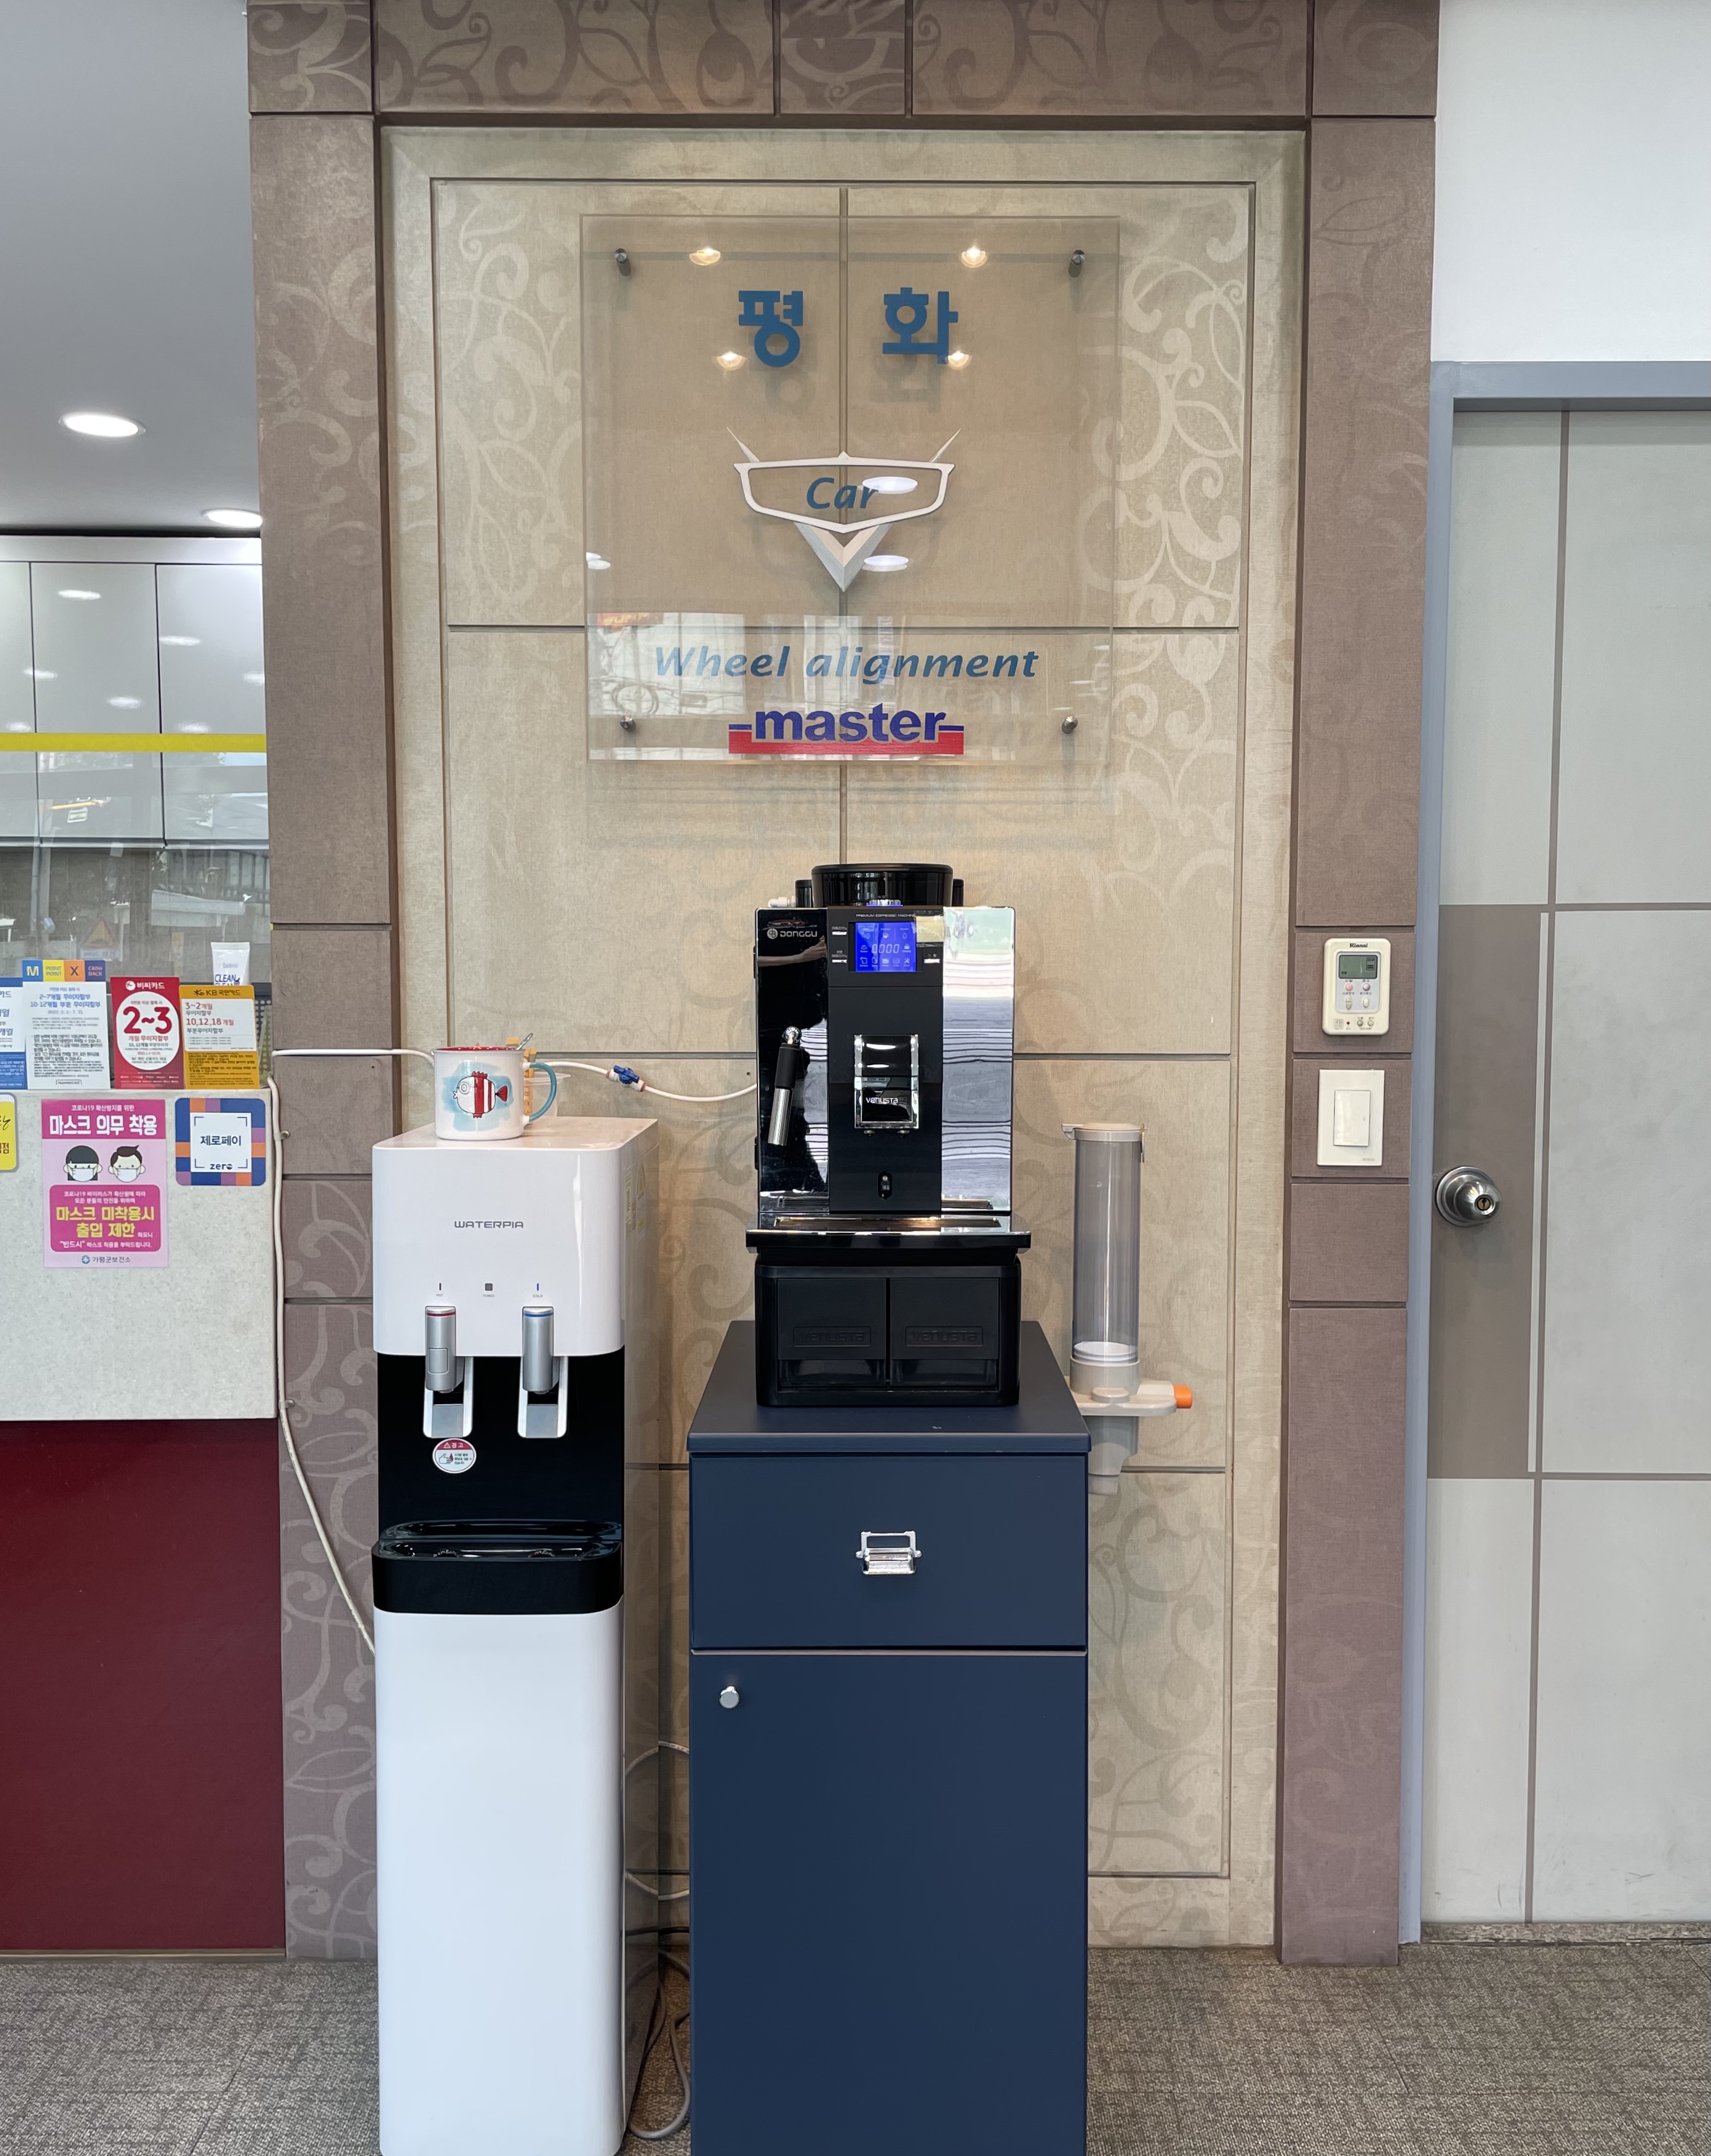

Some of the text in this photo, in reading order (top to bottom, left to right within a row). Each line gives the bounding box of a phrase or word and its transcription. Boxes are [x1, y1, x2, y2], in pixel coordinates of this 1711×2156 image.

[807, 477, 879, 509] Car
[655, 646, 790, 677] Wheel
[805, 646, 1039, 684] alignment
[755, 703, 946, 742] master
[871, 944, 900, 953] 0000
[27, 966, 39, 976] M
[70, 966, 79, 976] X
[123, 1006, 172, 1034] 2~3
[50, 1114, 157, 1136] 마스크 의무 착용
[0, 1142, 10, 1154] 점
[200, 1135, 241, 1146] 제로페이
[56, 1206, 154, 1221] 마스크 미착용시
[77, 1223, 103, 1238] 출입
[108, 1223, 135, 1238] 제한
